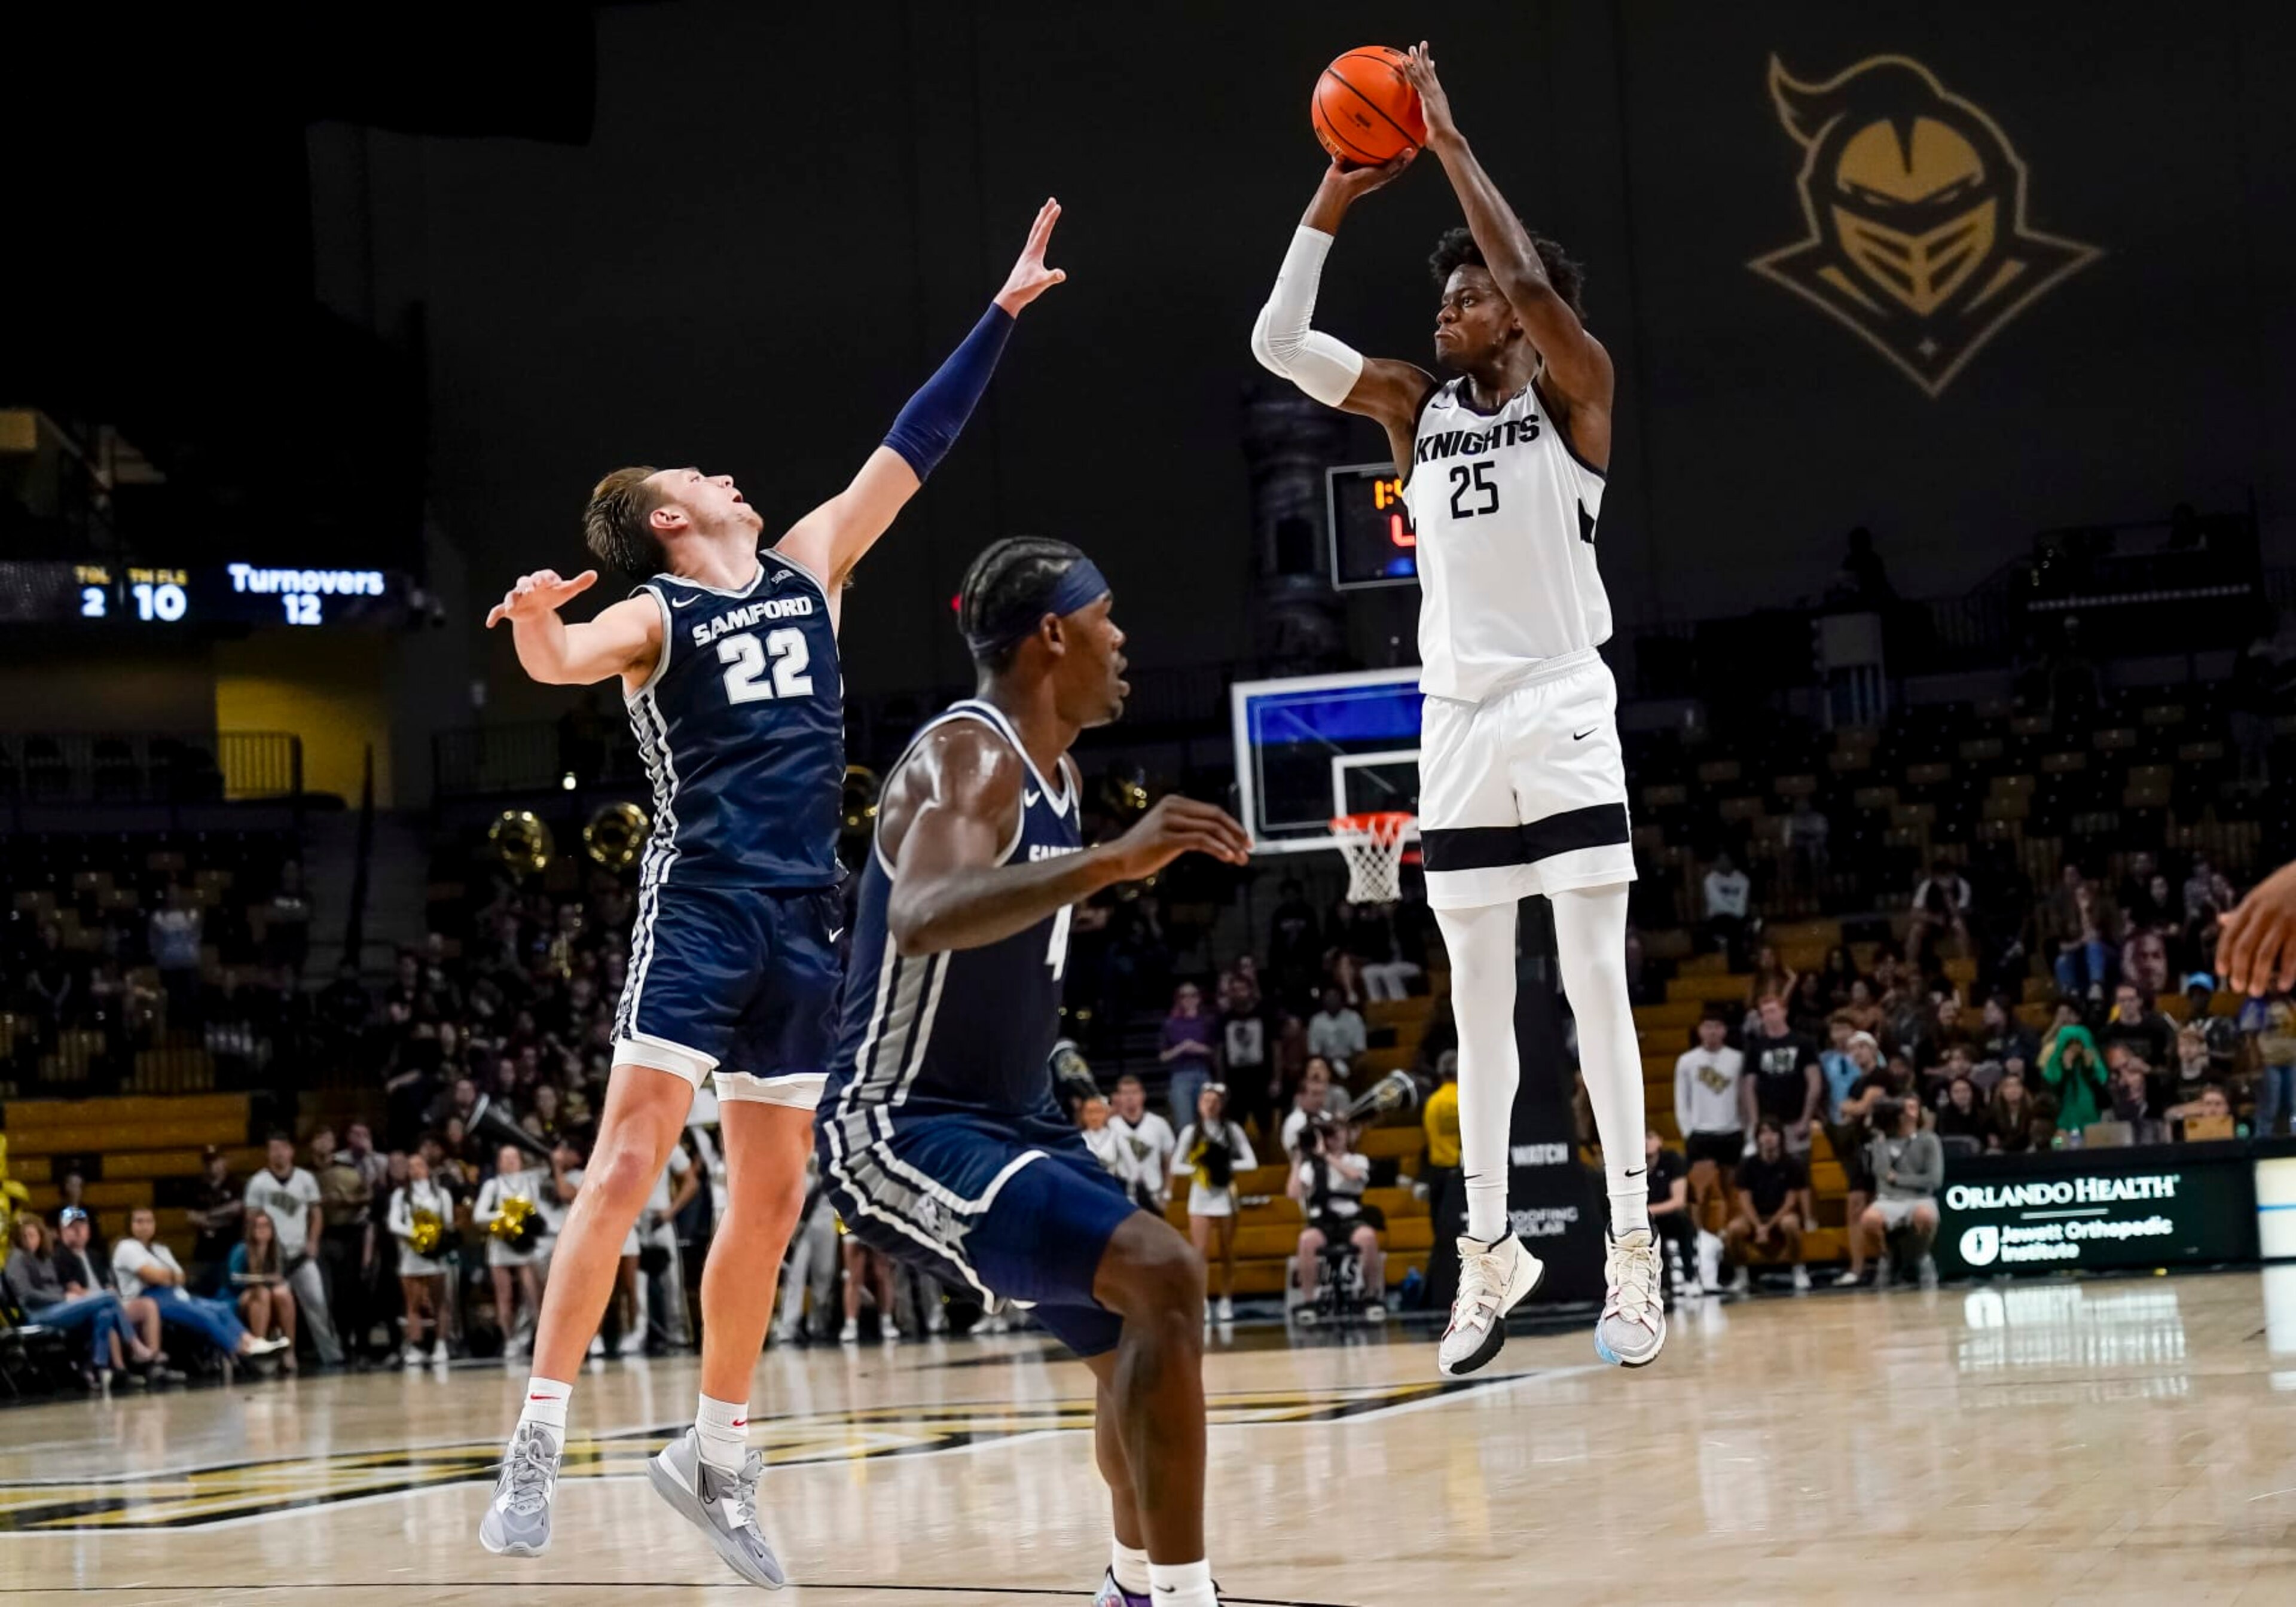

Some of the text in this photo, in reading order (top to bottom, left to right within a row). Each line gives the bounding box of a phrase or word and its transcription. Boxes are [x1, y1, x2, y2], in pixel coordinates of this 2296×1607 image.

[1416, 414, 1540, 465] KNIGHTS
[1450, 461, 1499, 519] 25
[228, 563, 384, 595] Turnovers
[82, 587, 105, 616] 2
[132, 583, 187, 621] 10
[283, 593, 323, 625] 12
[692, 597, 813, 647] SAMFORD
[717, 627, 814, 705] 22
[1946, 1181, 2074, 1210] ORLANDO
[2065, 1215, 2173, 1241] Orthopedic
